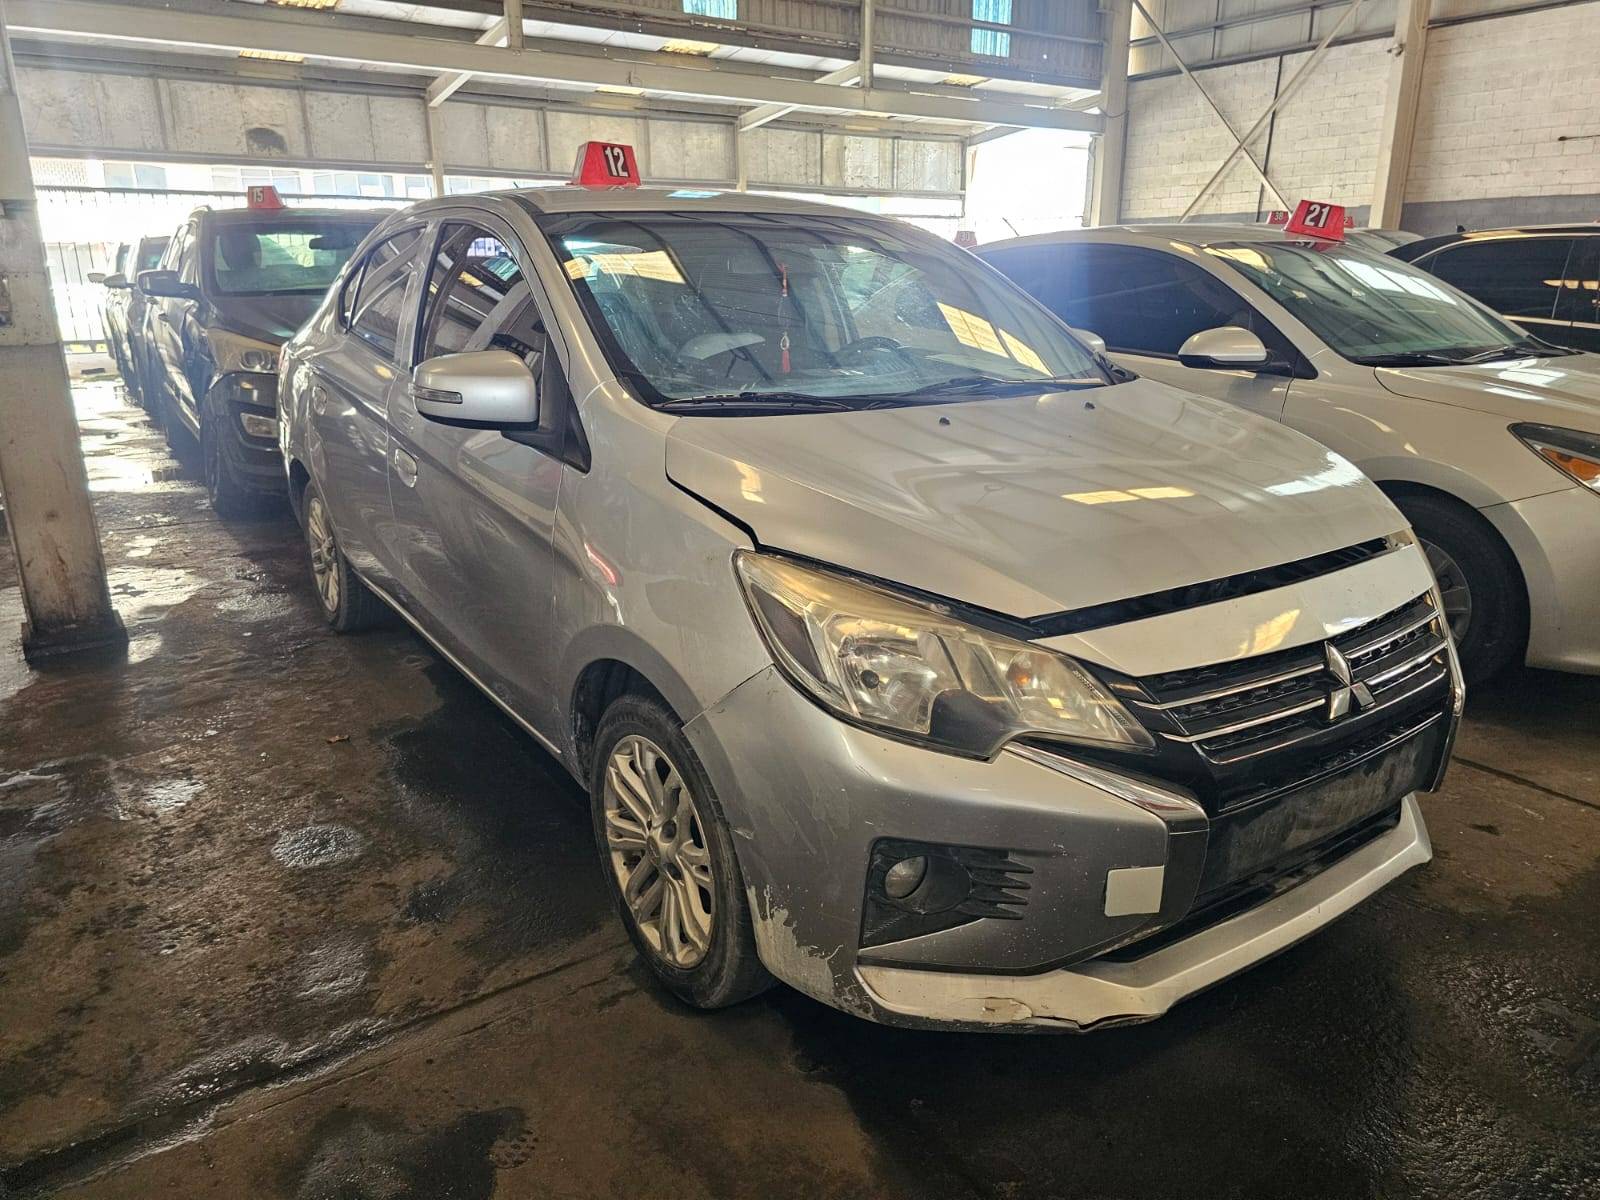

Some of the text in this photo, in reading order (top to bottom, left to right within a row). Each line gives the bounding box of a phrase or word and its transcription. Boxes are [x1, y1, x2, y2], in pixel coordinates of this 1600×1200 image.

[604, 146, 629, 177] 12
[252, 187, 264, 202] 15
[1304, 203, 1330, 228] 21
